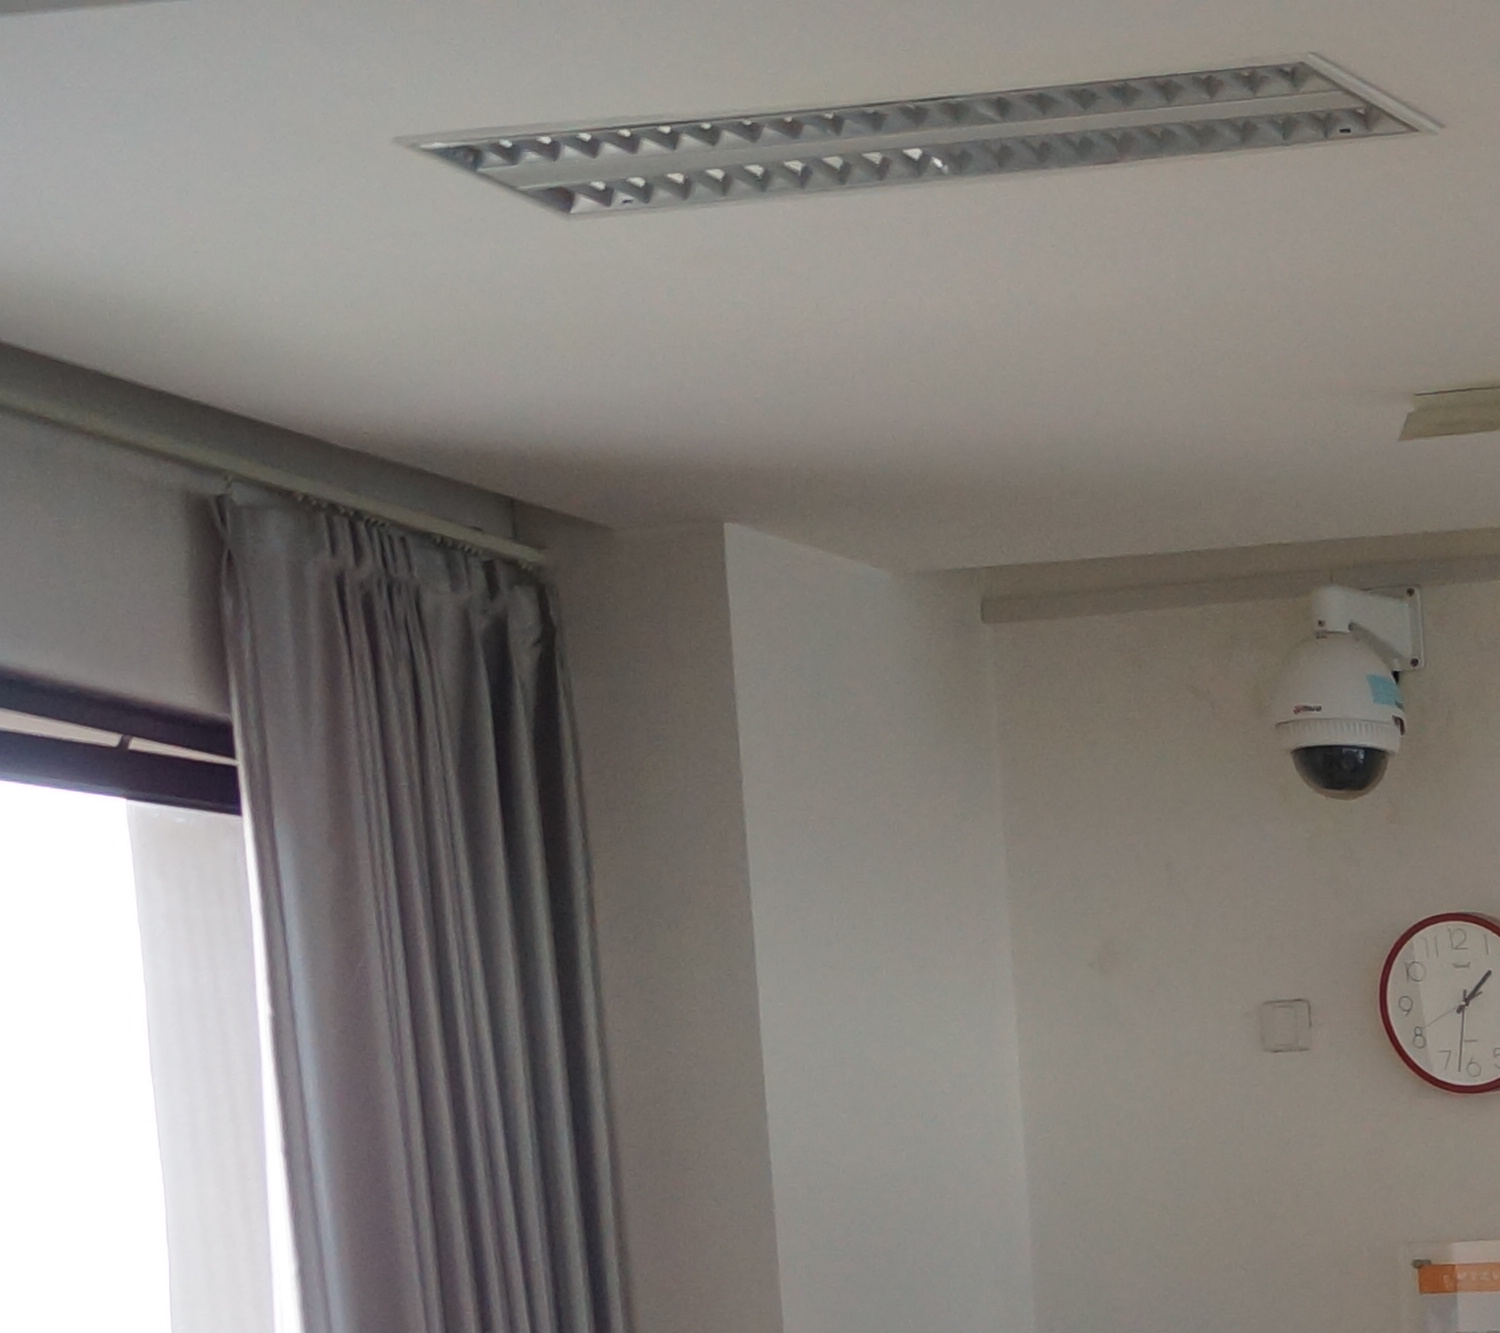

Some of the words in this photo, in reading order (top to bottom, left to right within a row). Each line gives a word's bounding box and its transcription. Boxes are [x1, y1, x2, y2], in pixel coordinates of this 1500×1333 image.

[1421, 935, 1439, 958] 11
[1448, 926, 1468, 950] 12
[1405, 960, 1427, 983] 10
[1398, 995, 1414, 1017] 9
[1412, 1026, 1427, 1049] 8
[1439, 1049, 1451, 1071] 7
[1466, 1056, 1482, 1078] 6
